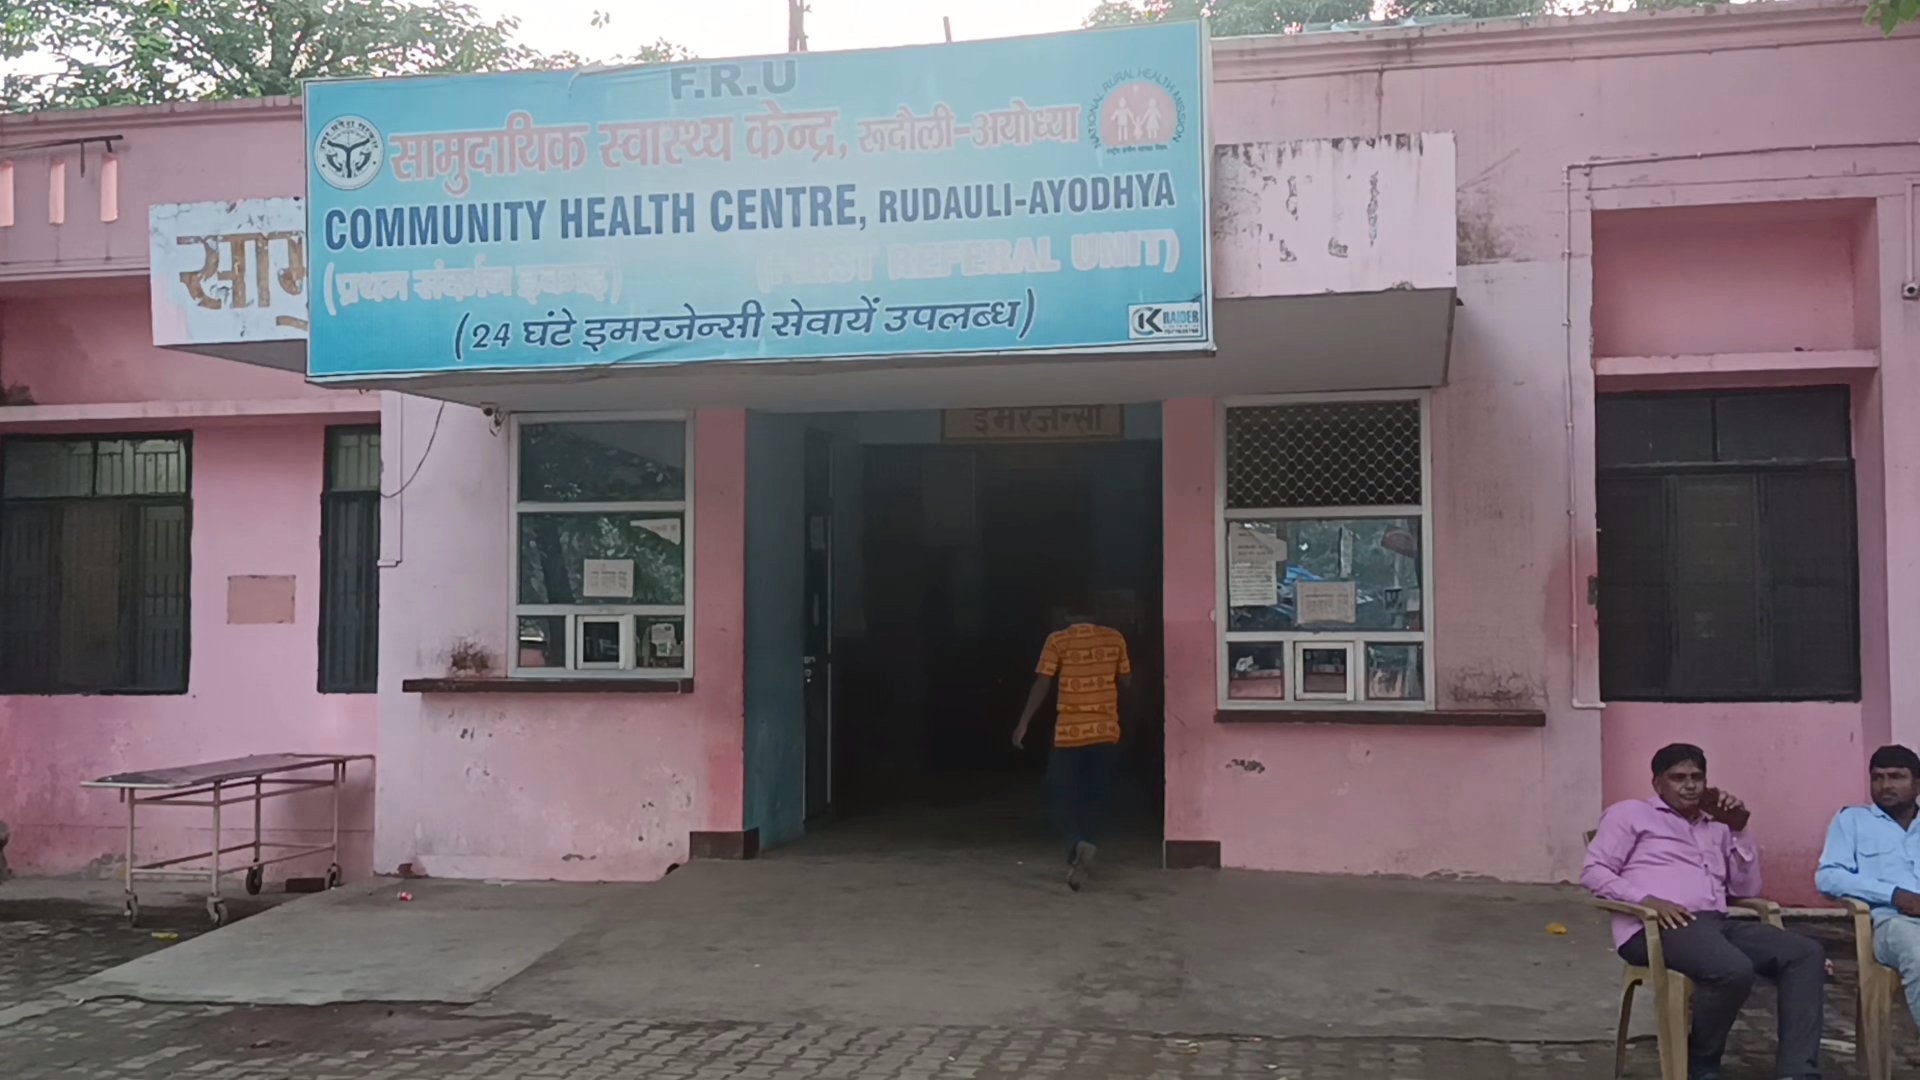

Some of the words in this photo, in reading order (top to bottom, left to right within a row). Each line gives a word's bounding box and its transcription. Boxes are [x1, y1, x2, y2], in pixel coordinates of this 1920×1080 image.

[670, 60, 796, 99] F.R.U
[389, 111, 589, 195] सामुदायिक
[598, 116, 733, 168] स्वास्थ्य
[743, 99, 848, 163] केन्द्र,
[325, 199, 547, 250] COMMUNITY
[560, 192, 695, 239] HEALTH
[710, 183, 866, 231] CENTRE,
[879, 171, 1176, 224] RUDAULI-AYODHYA
[887, 236, 1061, 280] REFERAL
[1071, 229, 1180, 273] UNIT)
[455, 312, 510, 360] (24
[523, 308, 577, 347] घंटे
[583, 299, 765, 351] इमरजेन्सी
[771, 295, 880, 336] सेवायें
[885, 288, 1035, 339] उपलब्ध)
